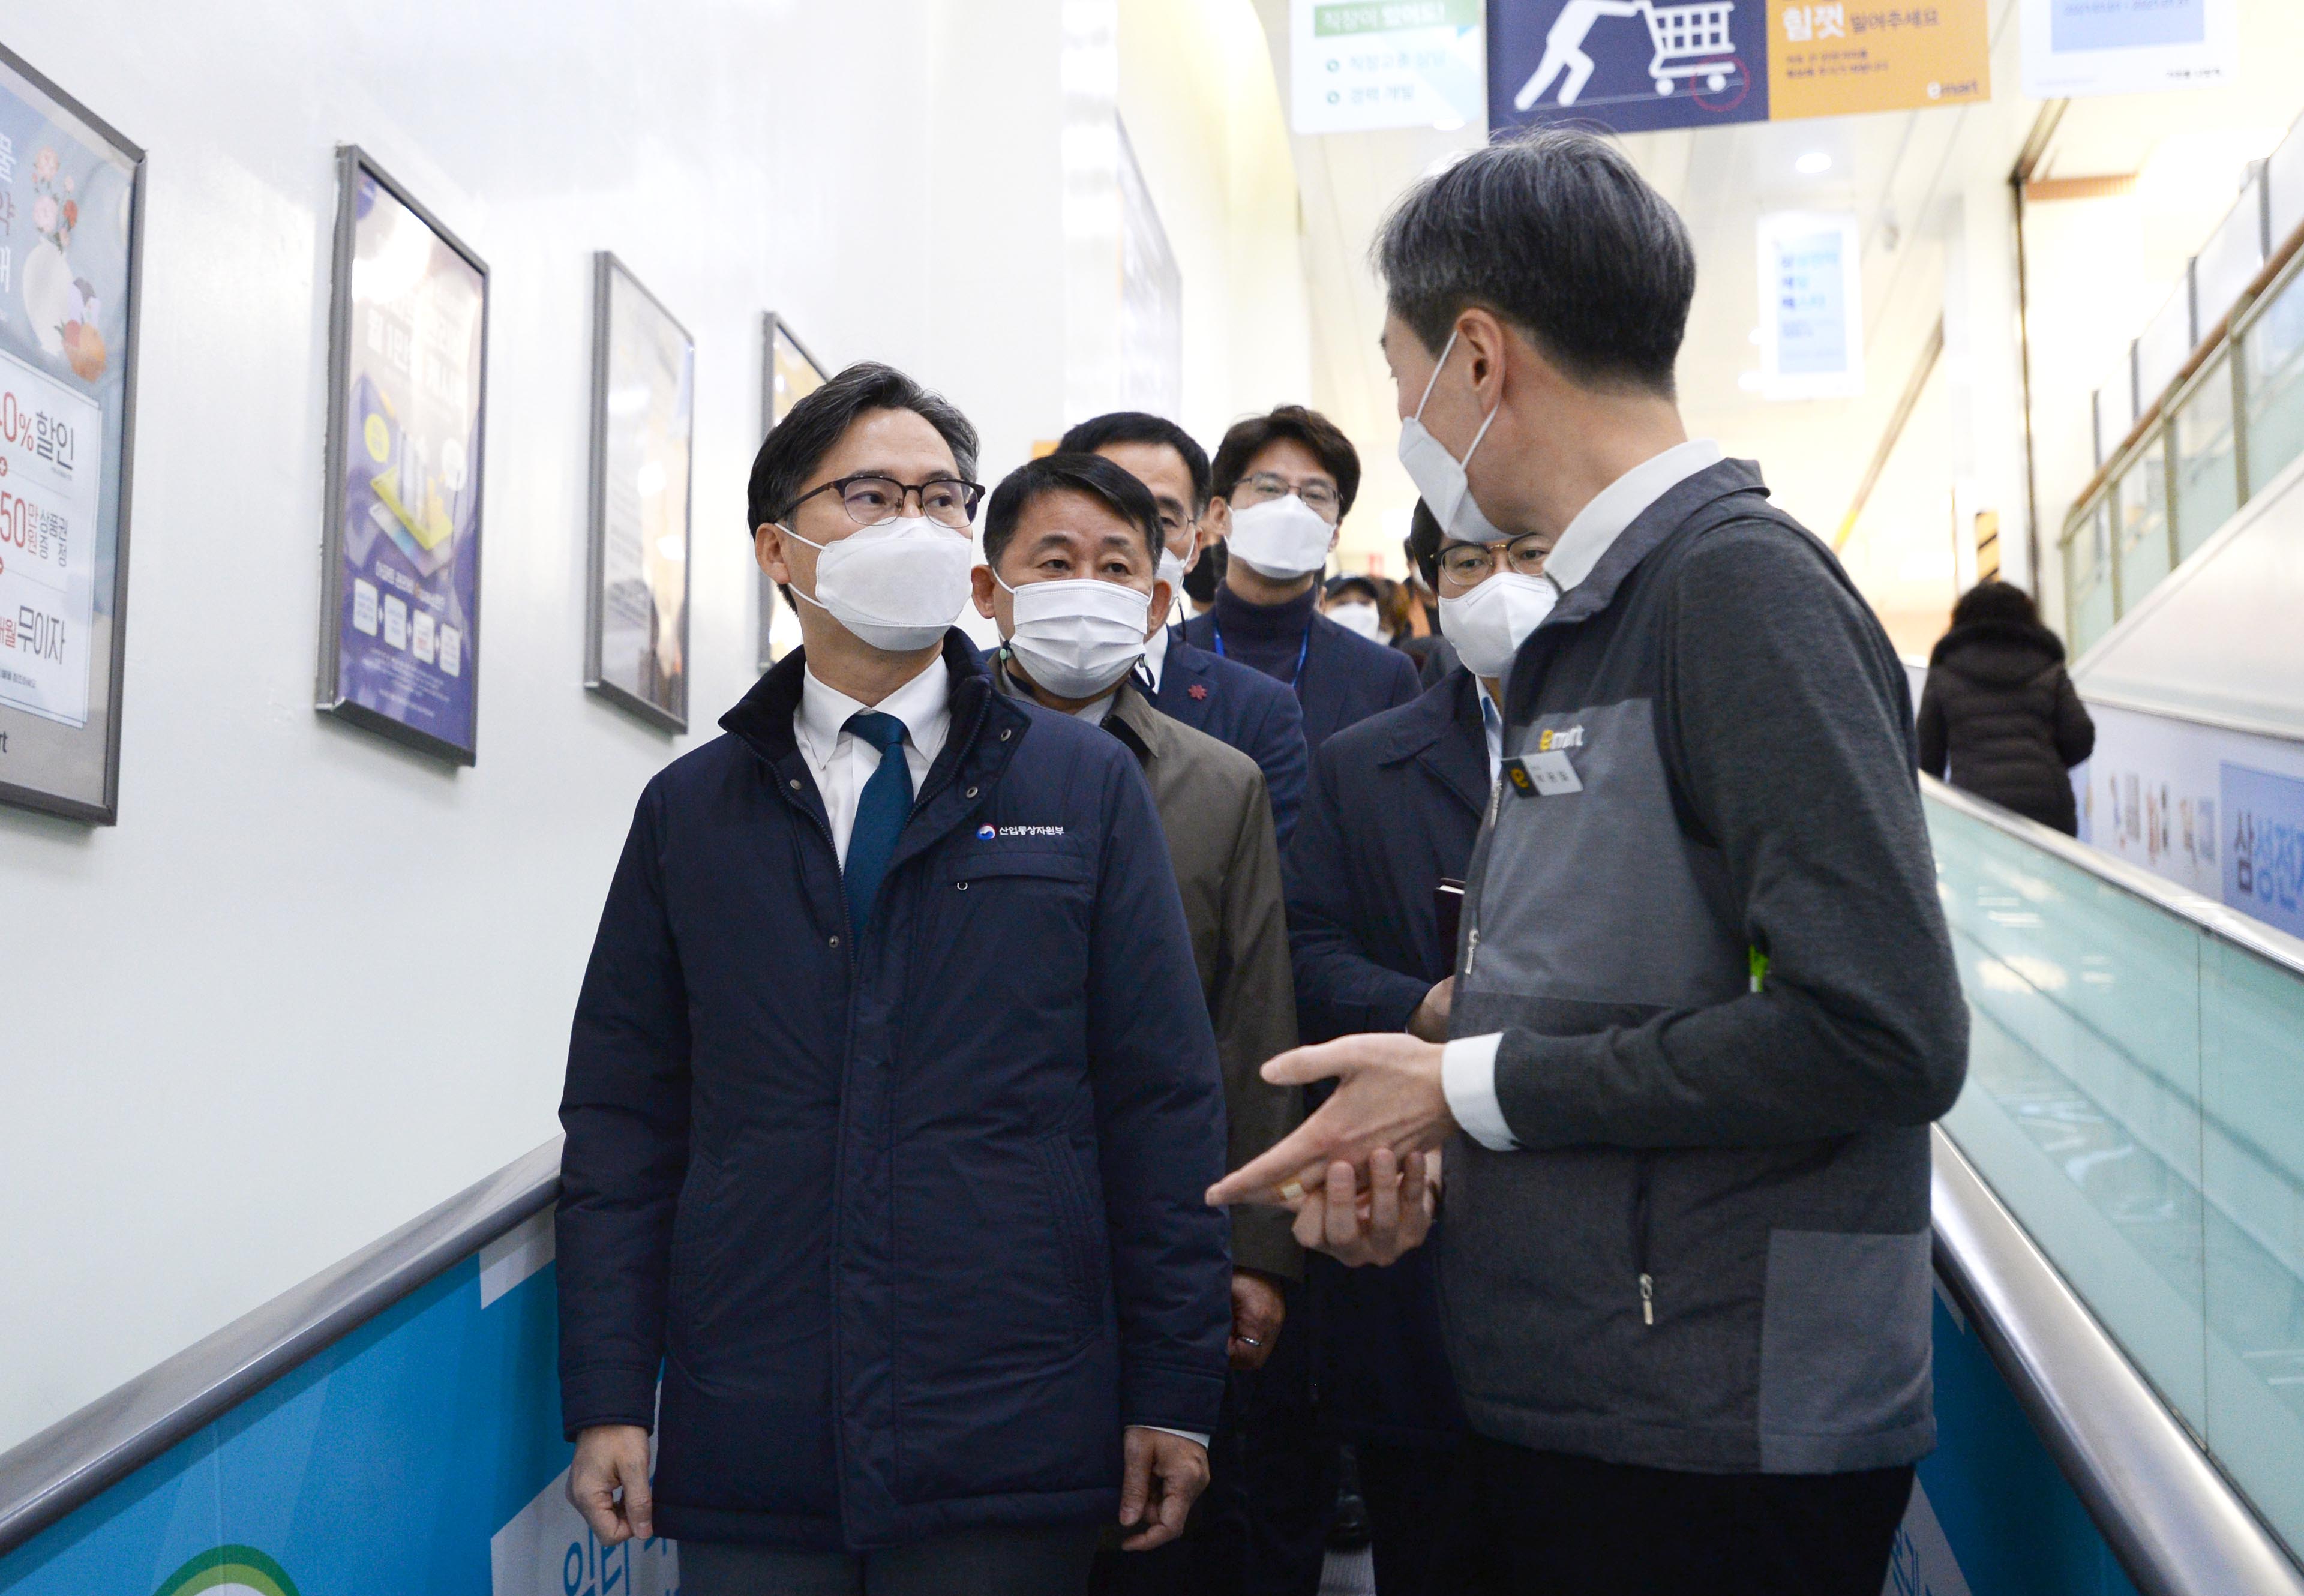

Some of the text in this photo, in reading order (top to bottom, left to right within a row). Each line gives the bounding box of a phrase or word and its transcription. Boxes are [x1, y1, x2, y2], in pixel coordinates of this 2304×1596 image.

[1783, 3, 1939, 41] 힘껏 밀어주세요
[998, 826, 1065, 836] 산업통상자원부
